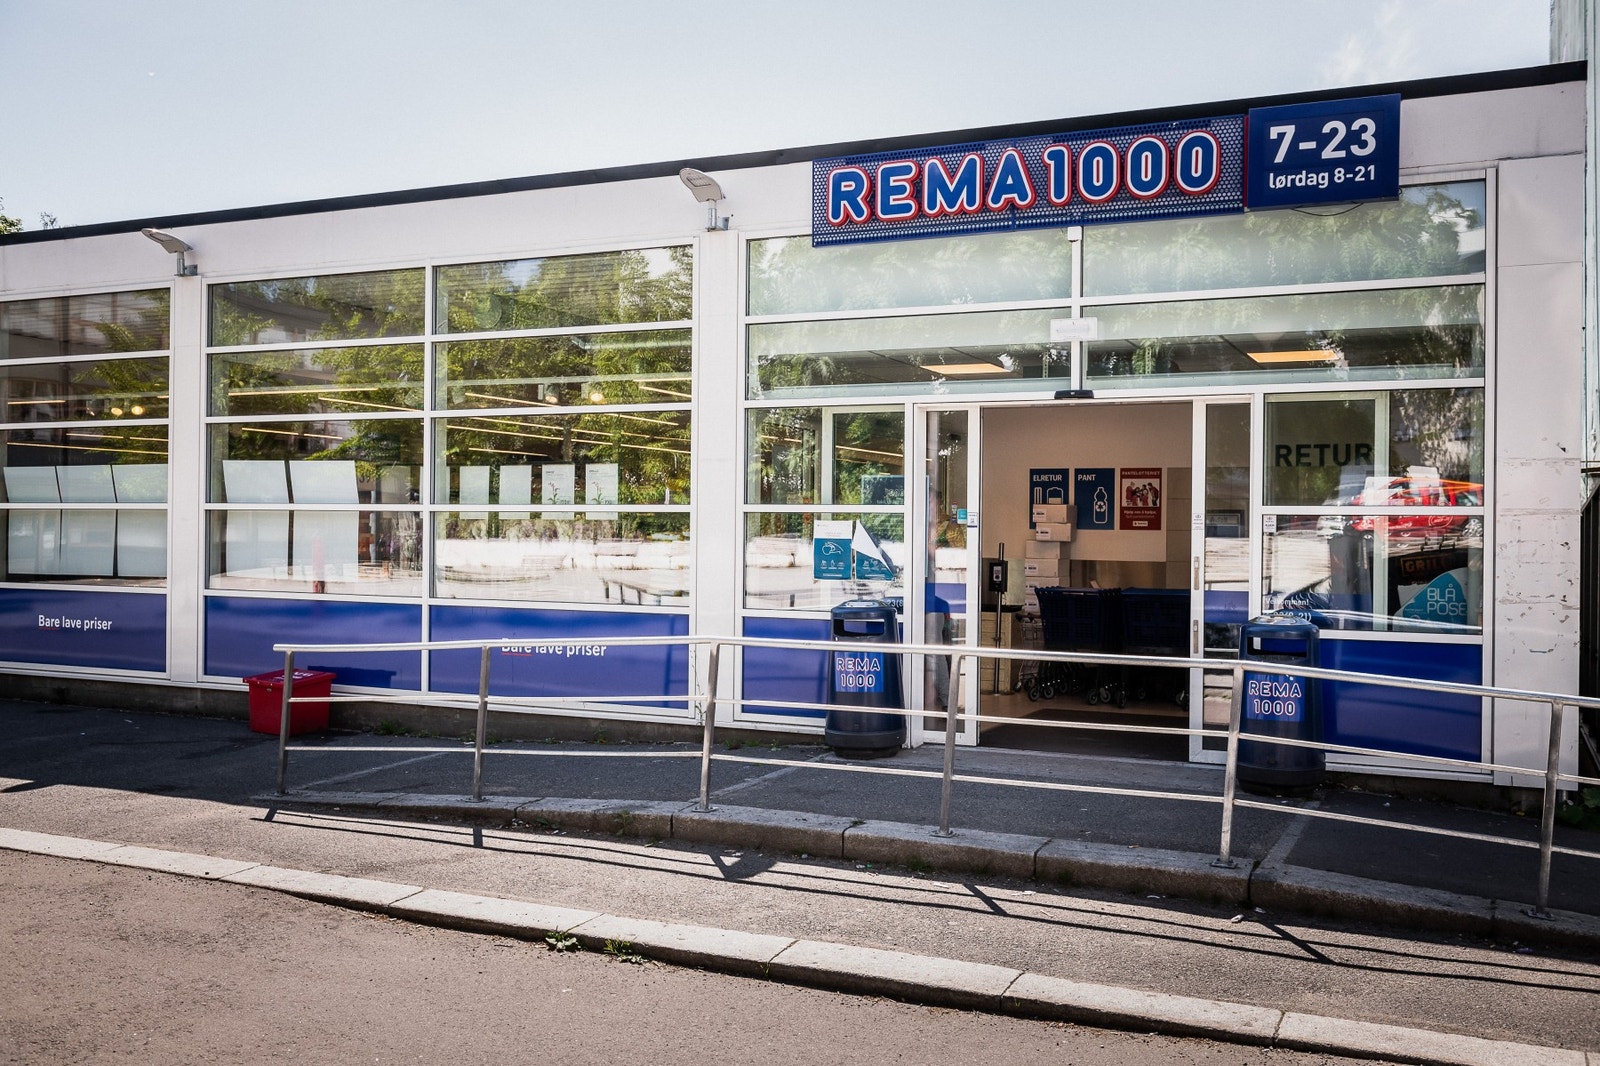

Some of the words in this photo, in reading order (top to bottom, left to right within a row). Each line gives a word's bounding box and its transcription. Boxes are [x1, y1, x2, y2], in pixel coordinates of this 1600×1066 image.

[1269, 118, 1377, 164] 7-23
[827, 147, 1036, 227] REMA
[1042, 129, 1221, 208] 1000
[1269, 170, 1329, 189] lørdag
[1333, 165, 1375, 183] 8-21
[1275, 443, 1373, 467] RETUR
[1033, 474, 1063, 482] ELRETUR
[1077, 474, 1096, 482] PANT
[1427, 583, 1456, 602] BLÅ
[1427, 601, 1467, 616] POSE
[38, 614, 60, 628] Bare
[62, 616, 82, 629] lave
[83, 617, 113, 631] priser
[836, 657, 881, 672] REMA
[841, 674, 876, 688] 1000
[1248, 680, 1302, 698] REMA
[1254, 699, 1296, 716] 1000
